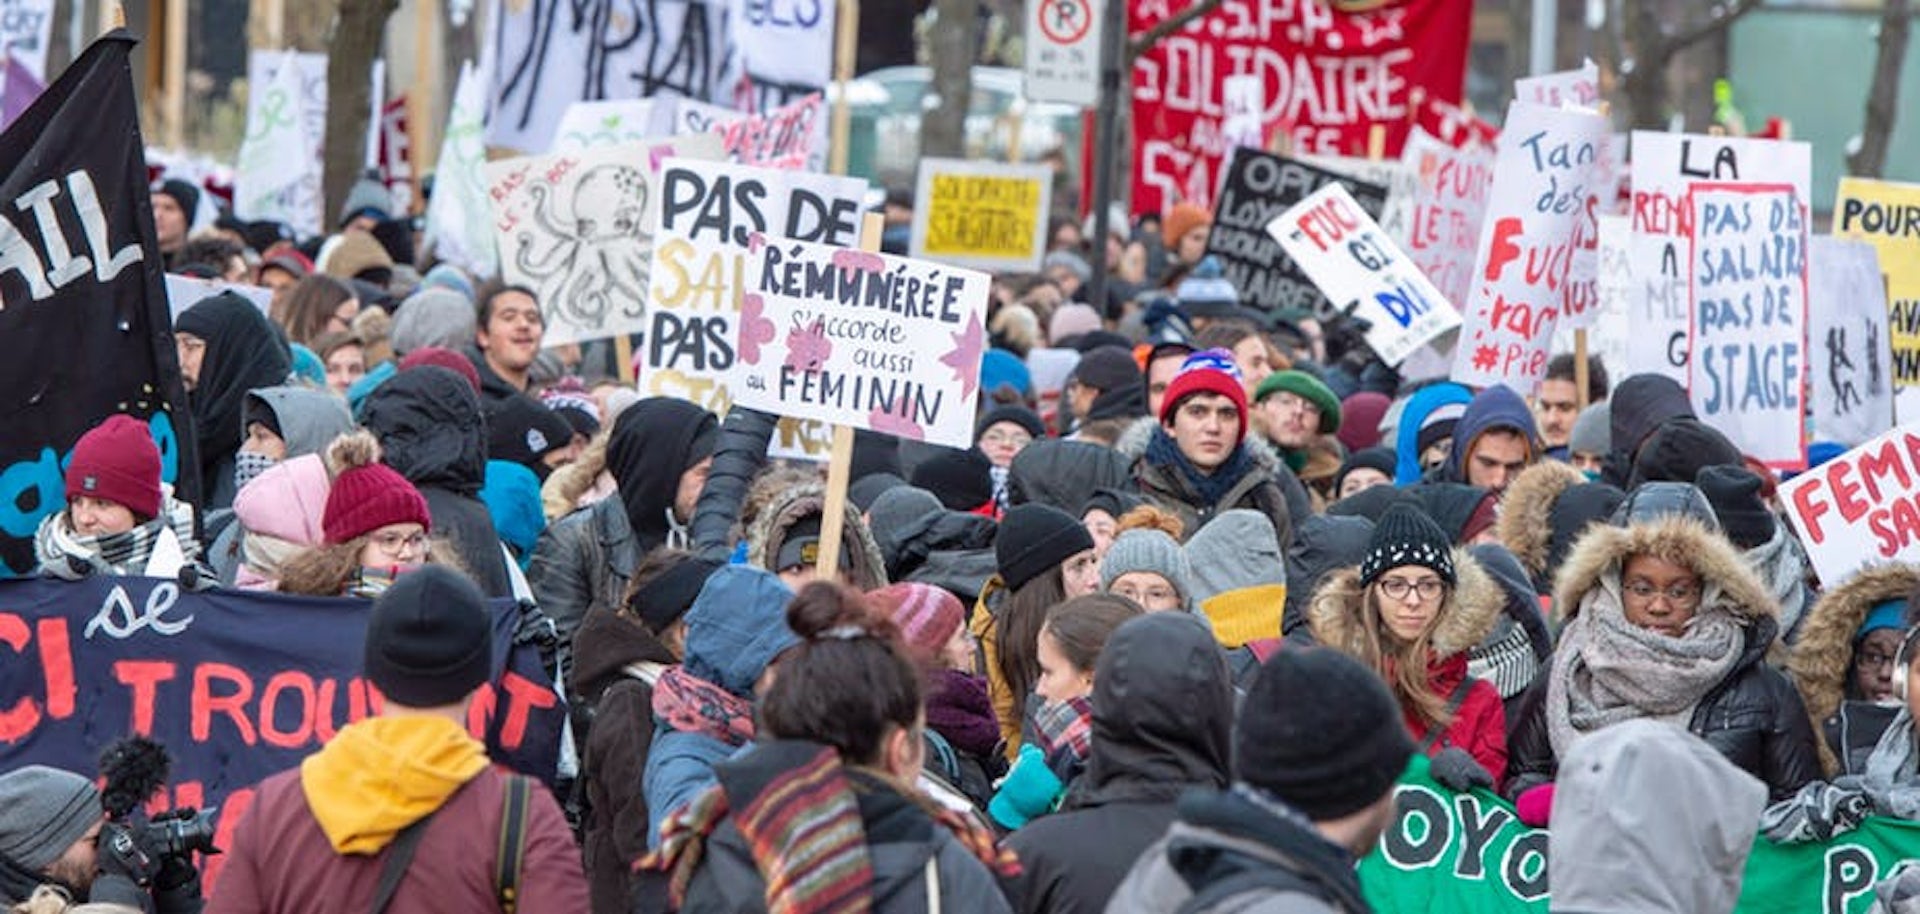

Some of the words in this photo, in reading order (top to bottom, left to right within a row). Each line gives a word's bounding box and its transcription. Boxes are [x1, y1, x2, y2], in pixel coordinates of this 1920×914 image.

[1681, 140, 1738, 179] LA
[662, 167, 767, 246] PAS
[785, 188, 858, 246] DE
[1537, 174, 1583, 216] des
[1702, 201, 1751, 237] PAS
[1769, 193, 1801, 232] DE
[1842, 198, 1920, 239] POUR
[1411, 205, 1443, 250] LE
[759, 243, 966, 324] RÉMUNÉRÉE
[1699, 290, 1751, 335] PAS
[1761, 284, 1793, 326] DE
[649, 311, 734, 370] PAS
[853, 351, 914, 373] aussi
[779, 360, 943, 427] FÉMININ
[1702, 342, 1799, 415] STAGE
[1868, 492, 1920, 558] SA
[84, 581, 194, 639] se
